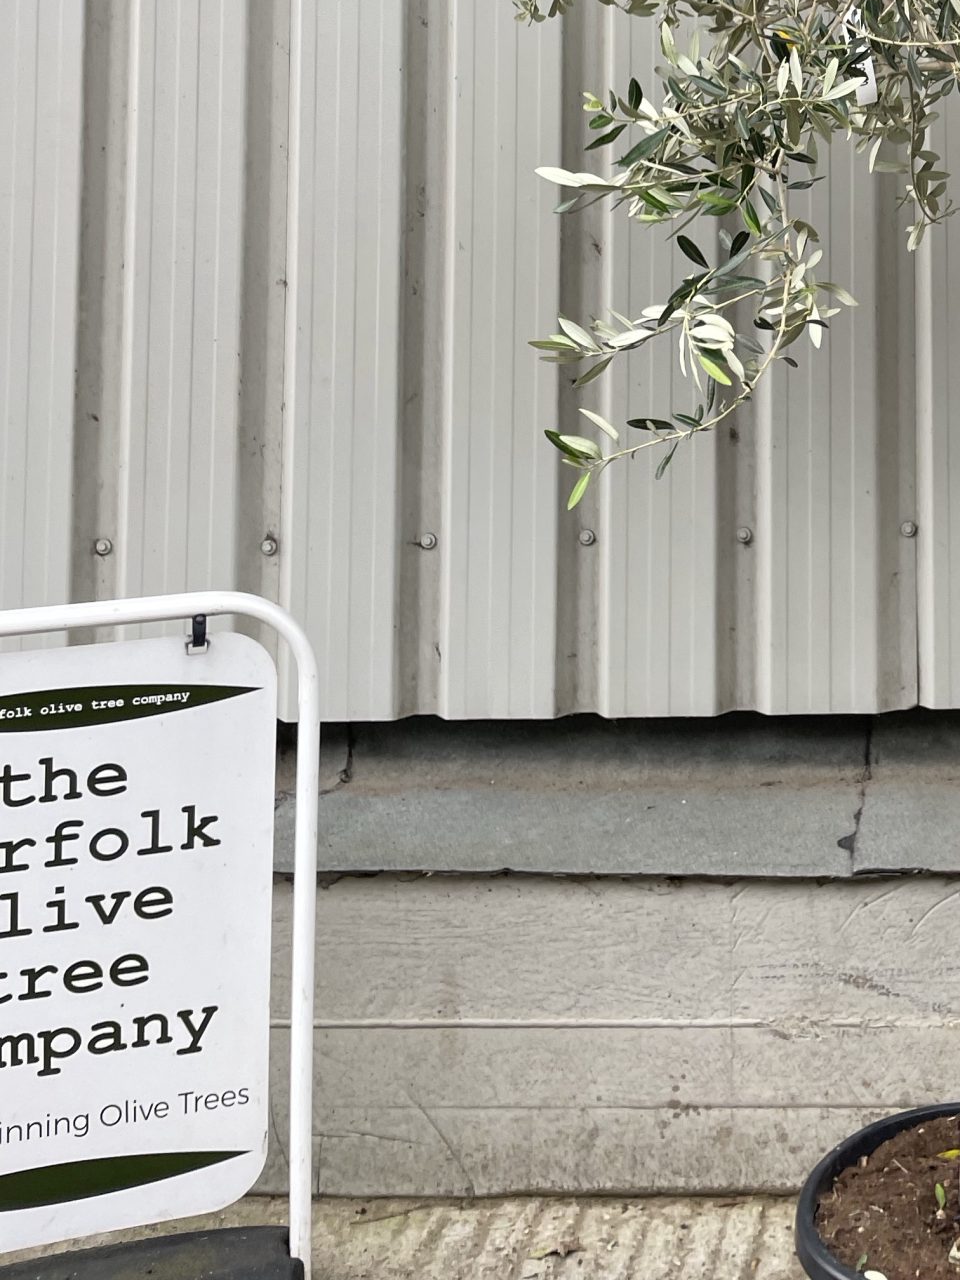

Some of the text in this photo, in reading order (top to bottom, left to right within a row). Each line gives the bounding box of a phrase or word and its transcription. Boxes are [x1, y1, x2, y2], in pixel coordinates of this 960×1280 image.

[40, 703, 83, 716] olive
[91, 697, 125, 710] tree
[132, 691, 191, 706] company
[0, 757, 128, 808] the
[0, 805, 221, 874] rfolk
[0, 886, 174, 939] live
[99, 1099, 170, 1127] Olive
[178, 1087, 250, 1115] Trees
